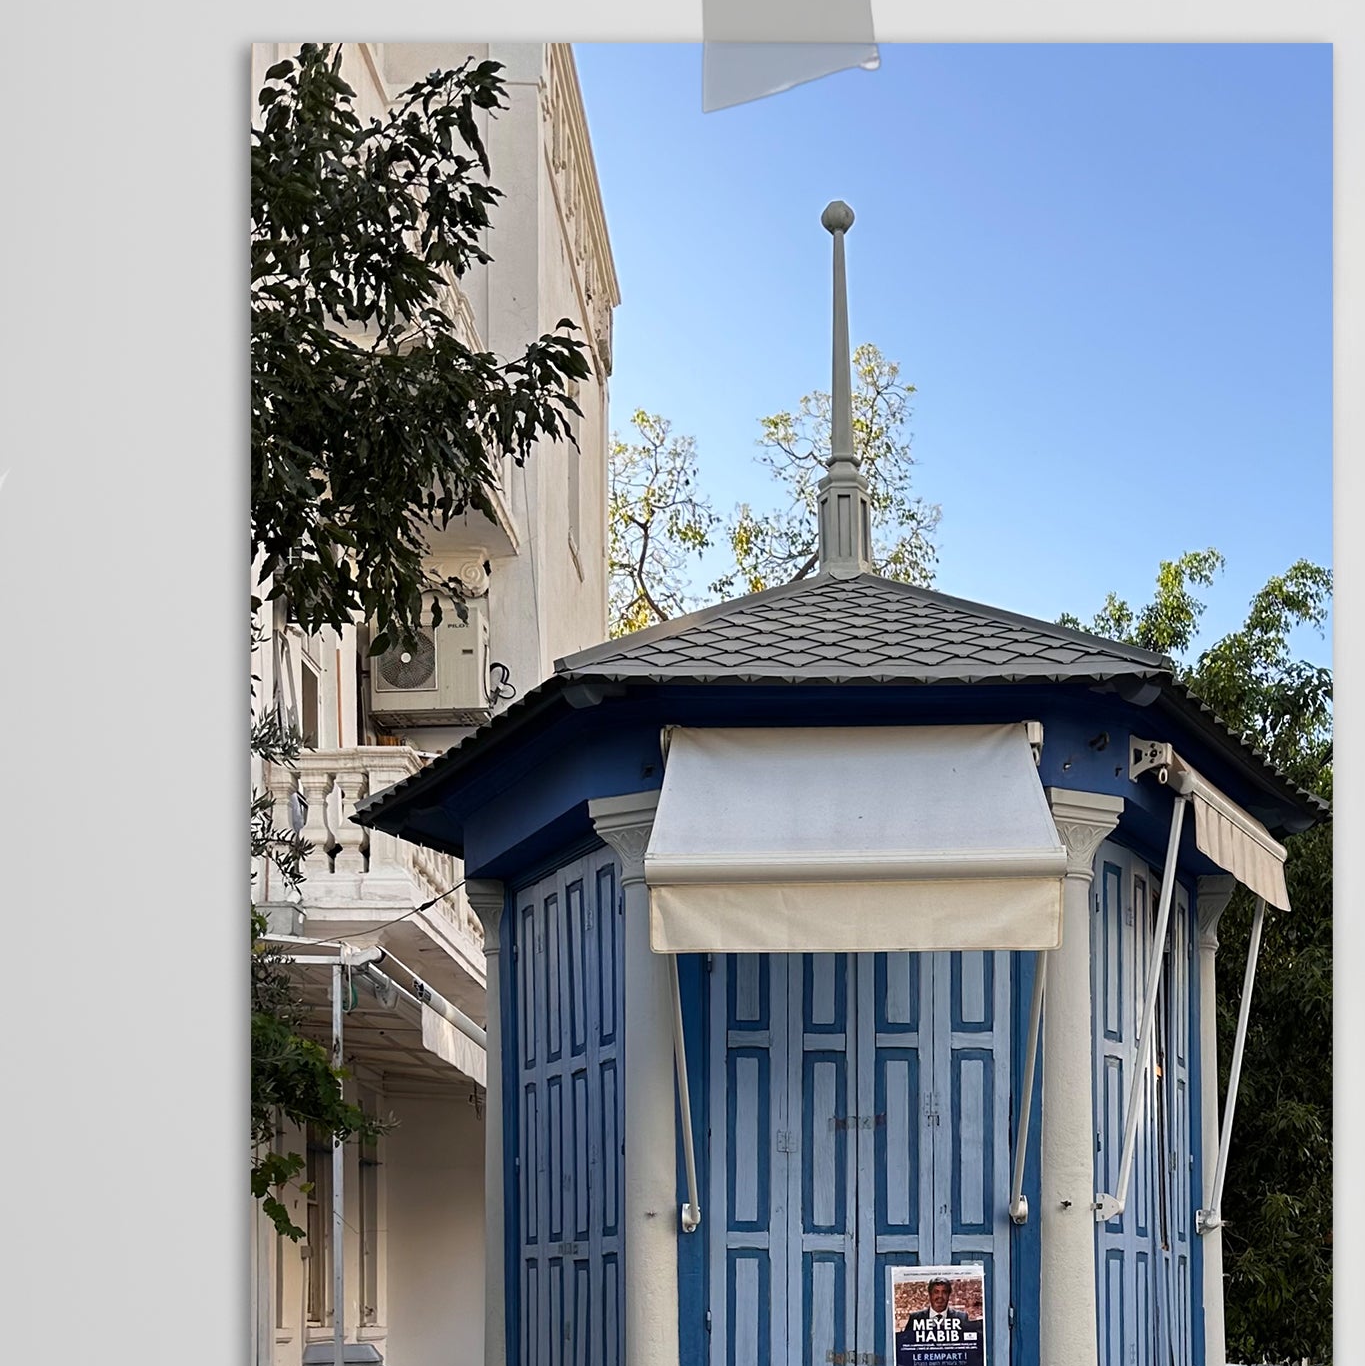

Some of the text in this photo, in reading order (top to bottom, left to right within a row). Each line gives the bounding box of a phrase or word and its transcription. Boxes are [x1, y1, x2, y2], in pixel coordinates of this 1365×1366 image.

[912, 1318, 962, 1331] MEYER
[915, 1330, 960, 1342] HABIB
[912, 1353, 922, 1361] LE
[923, 1352, 963, 1361] REMPART
